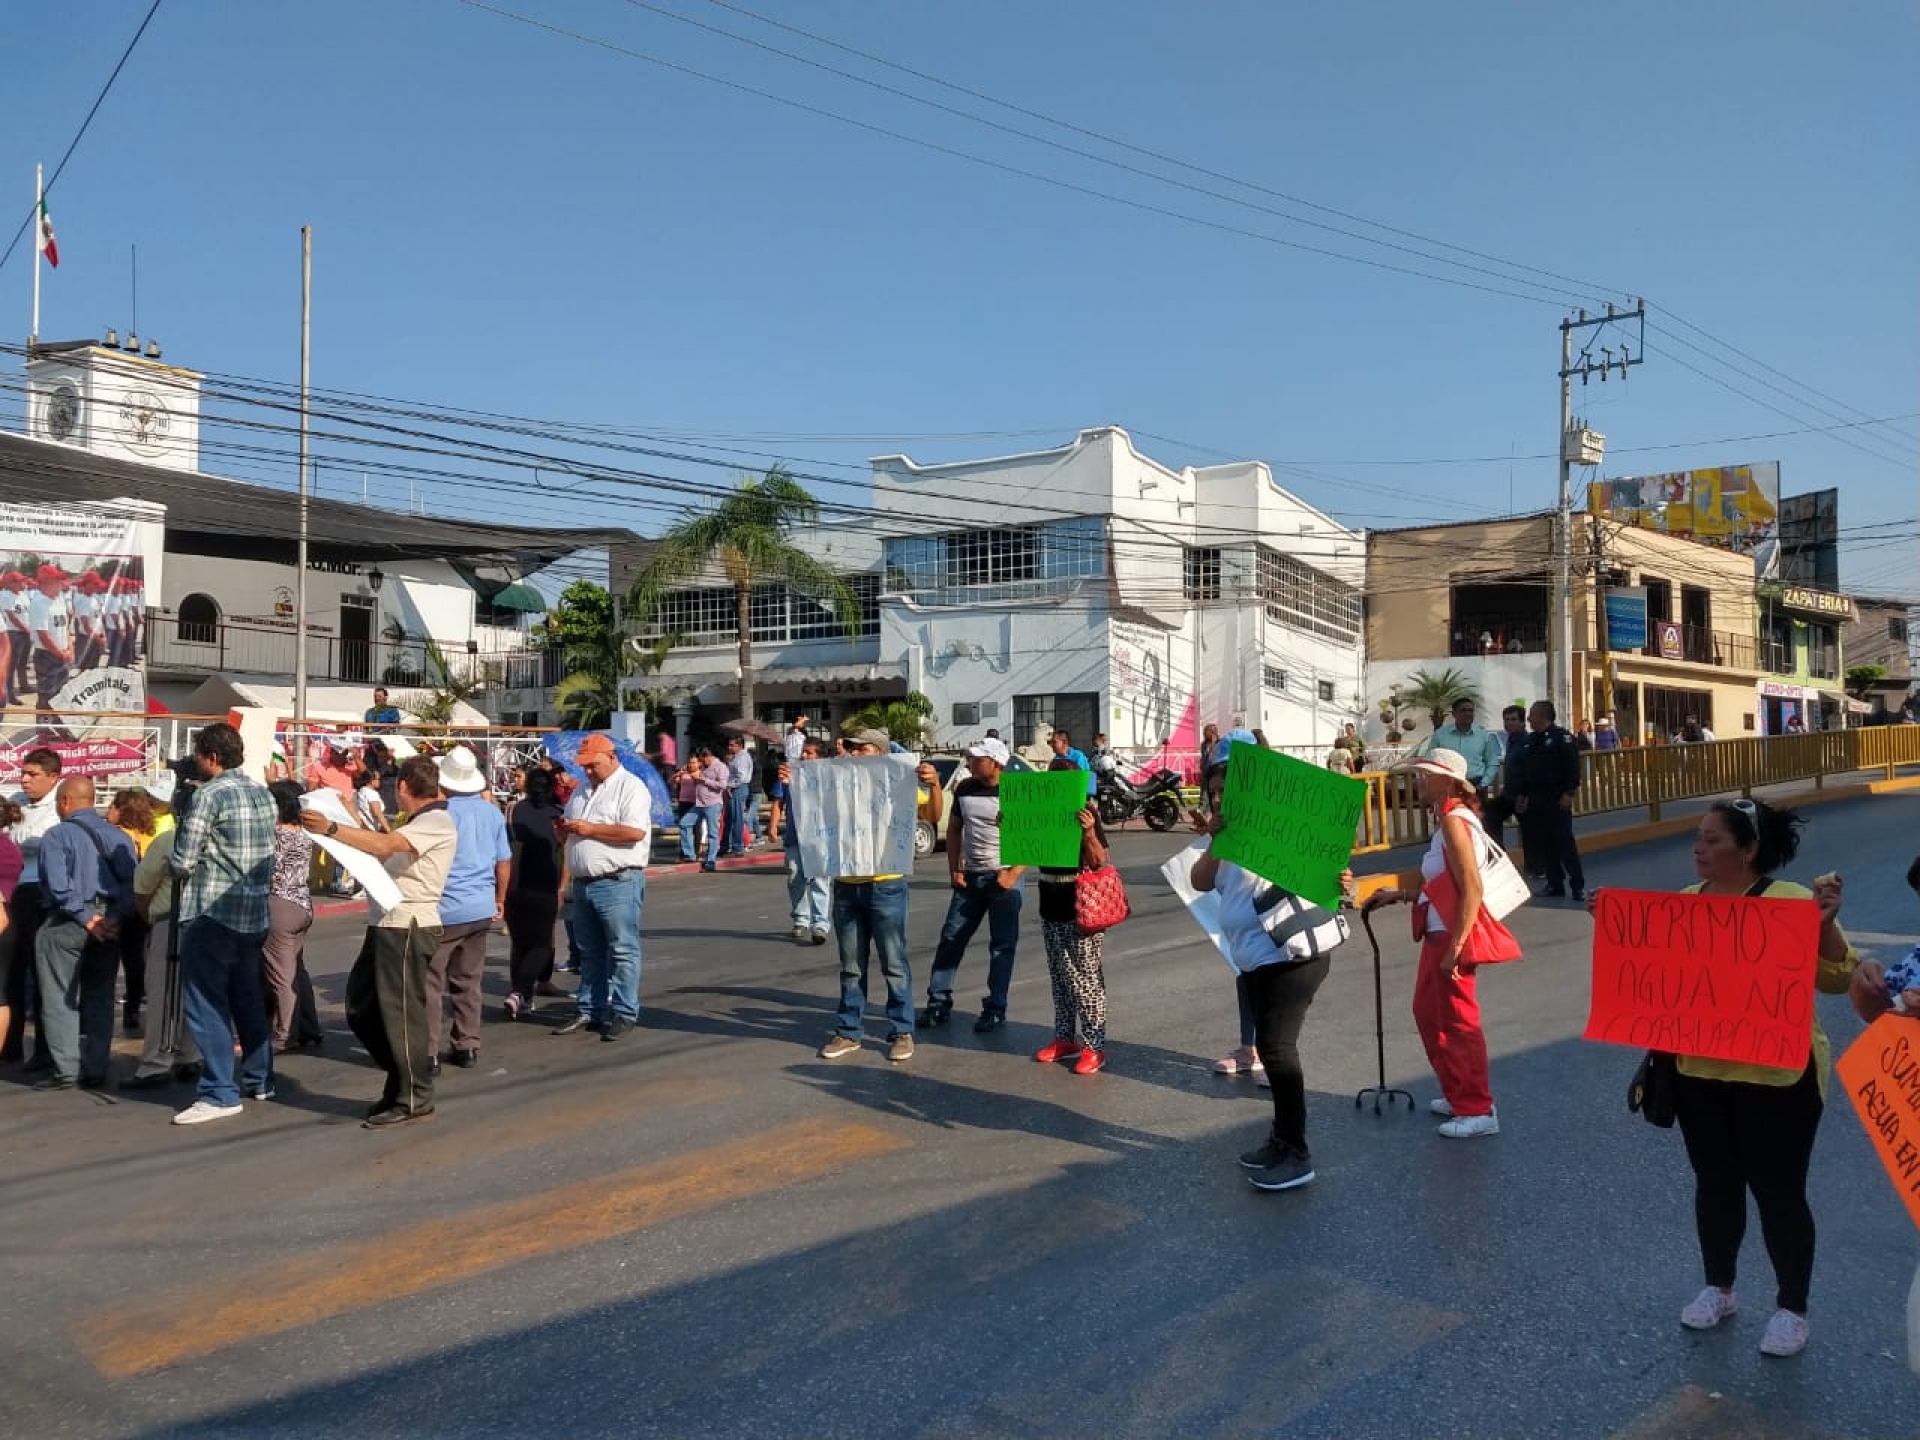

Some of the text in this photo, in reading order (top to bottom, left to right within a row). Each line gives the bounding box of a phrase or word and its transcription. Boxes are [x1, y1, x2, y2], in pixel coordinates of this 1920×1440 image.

[801, 682, 871, 695] CAJAS
[1231, 754, 1257, 792] NO
[1602, 893, 1807, 971] QUEREMOS
[1617, 959, 1808, 1028] AGUA NO
[1857, 1076, 1901, 1146] AGUA
